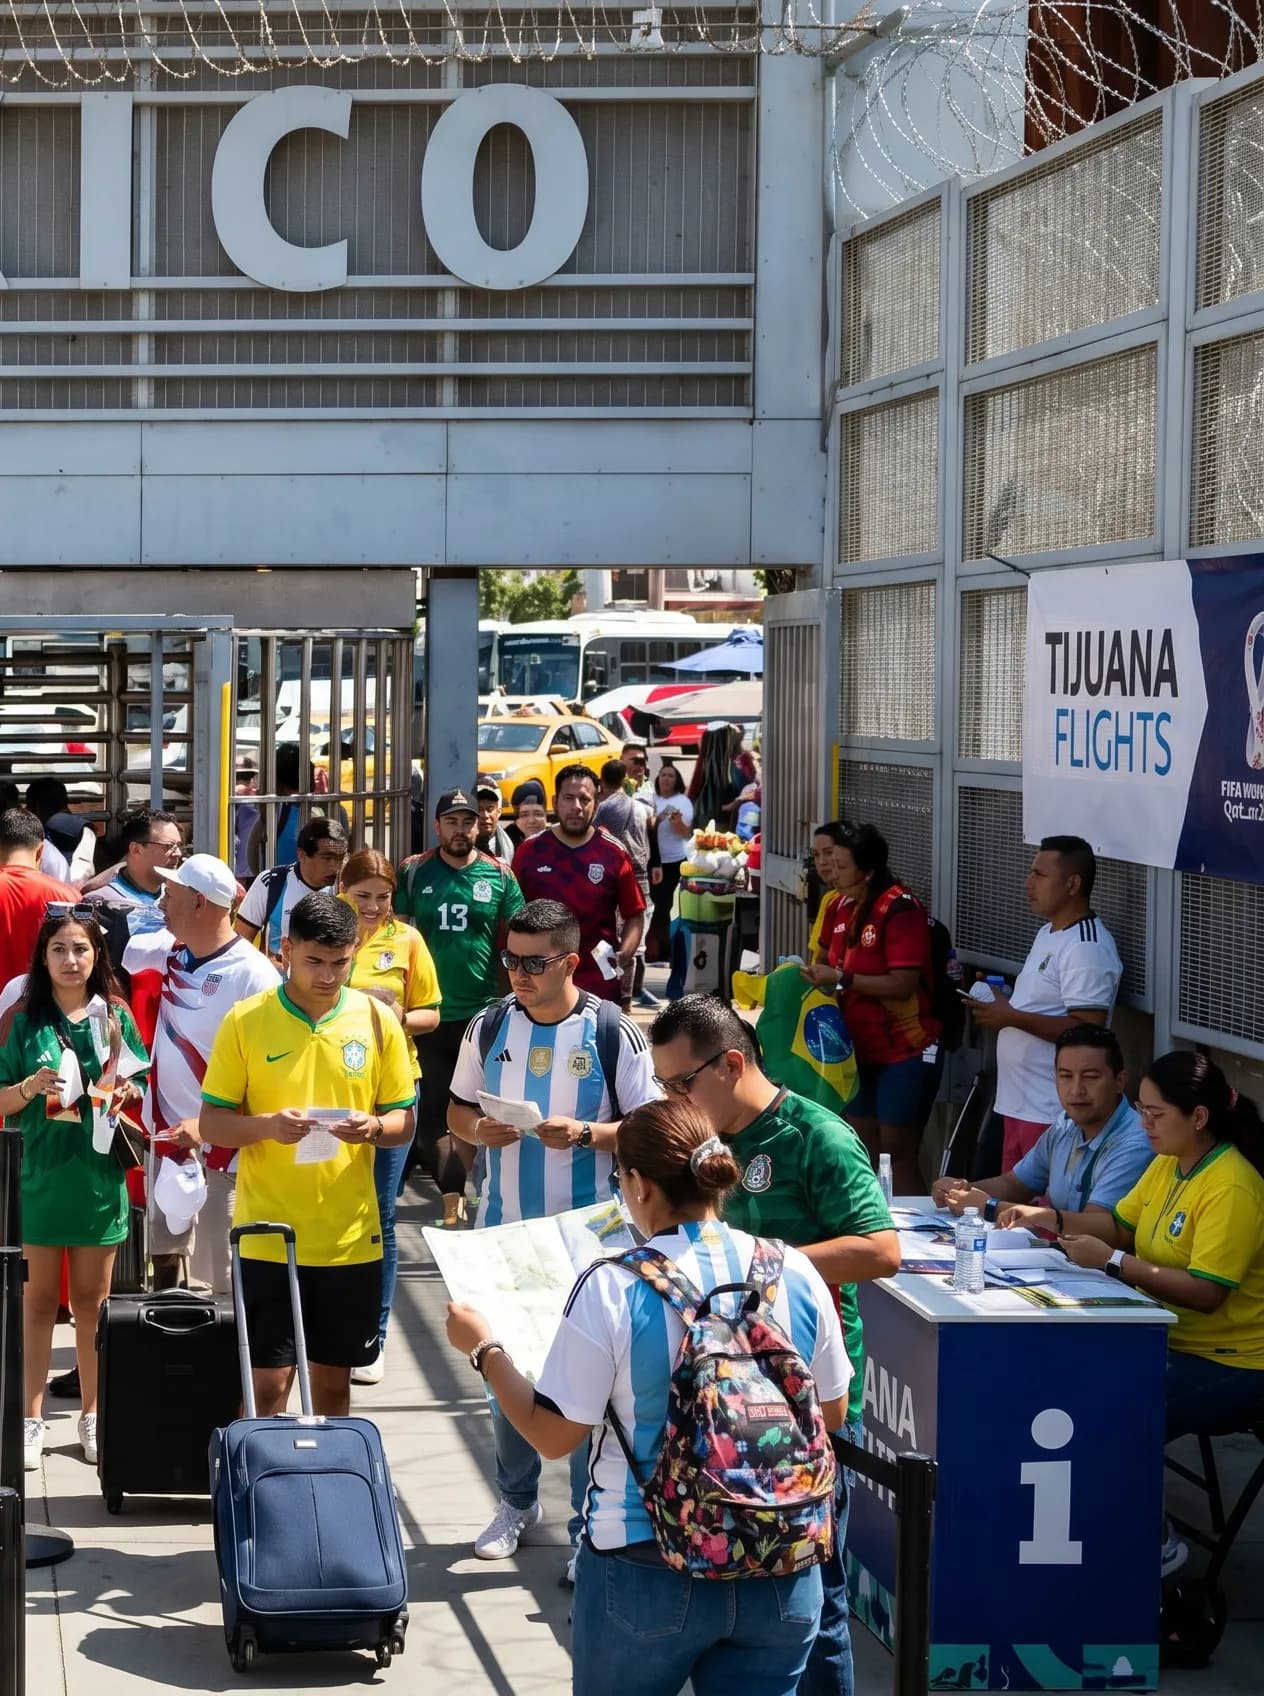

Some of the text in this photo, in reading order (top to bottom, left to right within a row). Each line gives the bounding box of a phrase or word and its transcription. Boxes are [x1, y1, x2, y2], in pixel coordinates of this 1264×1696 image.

[1045, 629, 1178, 697] TIJUANA
[1056, 709, 1171, 776] FLIGHTS
[1221, 780, 1243, 798] FIFA
[438, 902, 467, 931] 13
[862, 1355, 917, 1450] ANA
